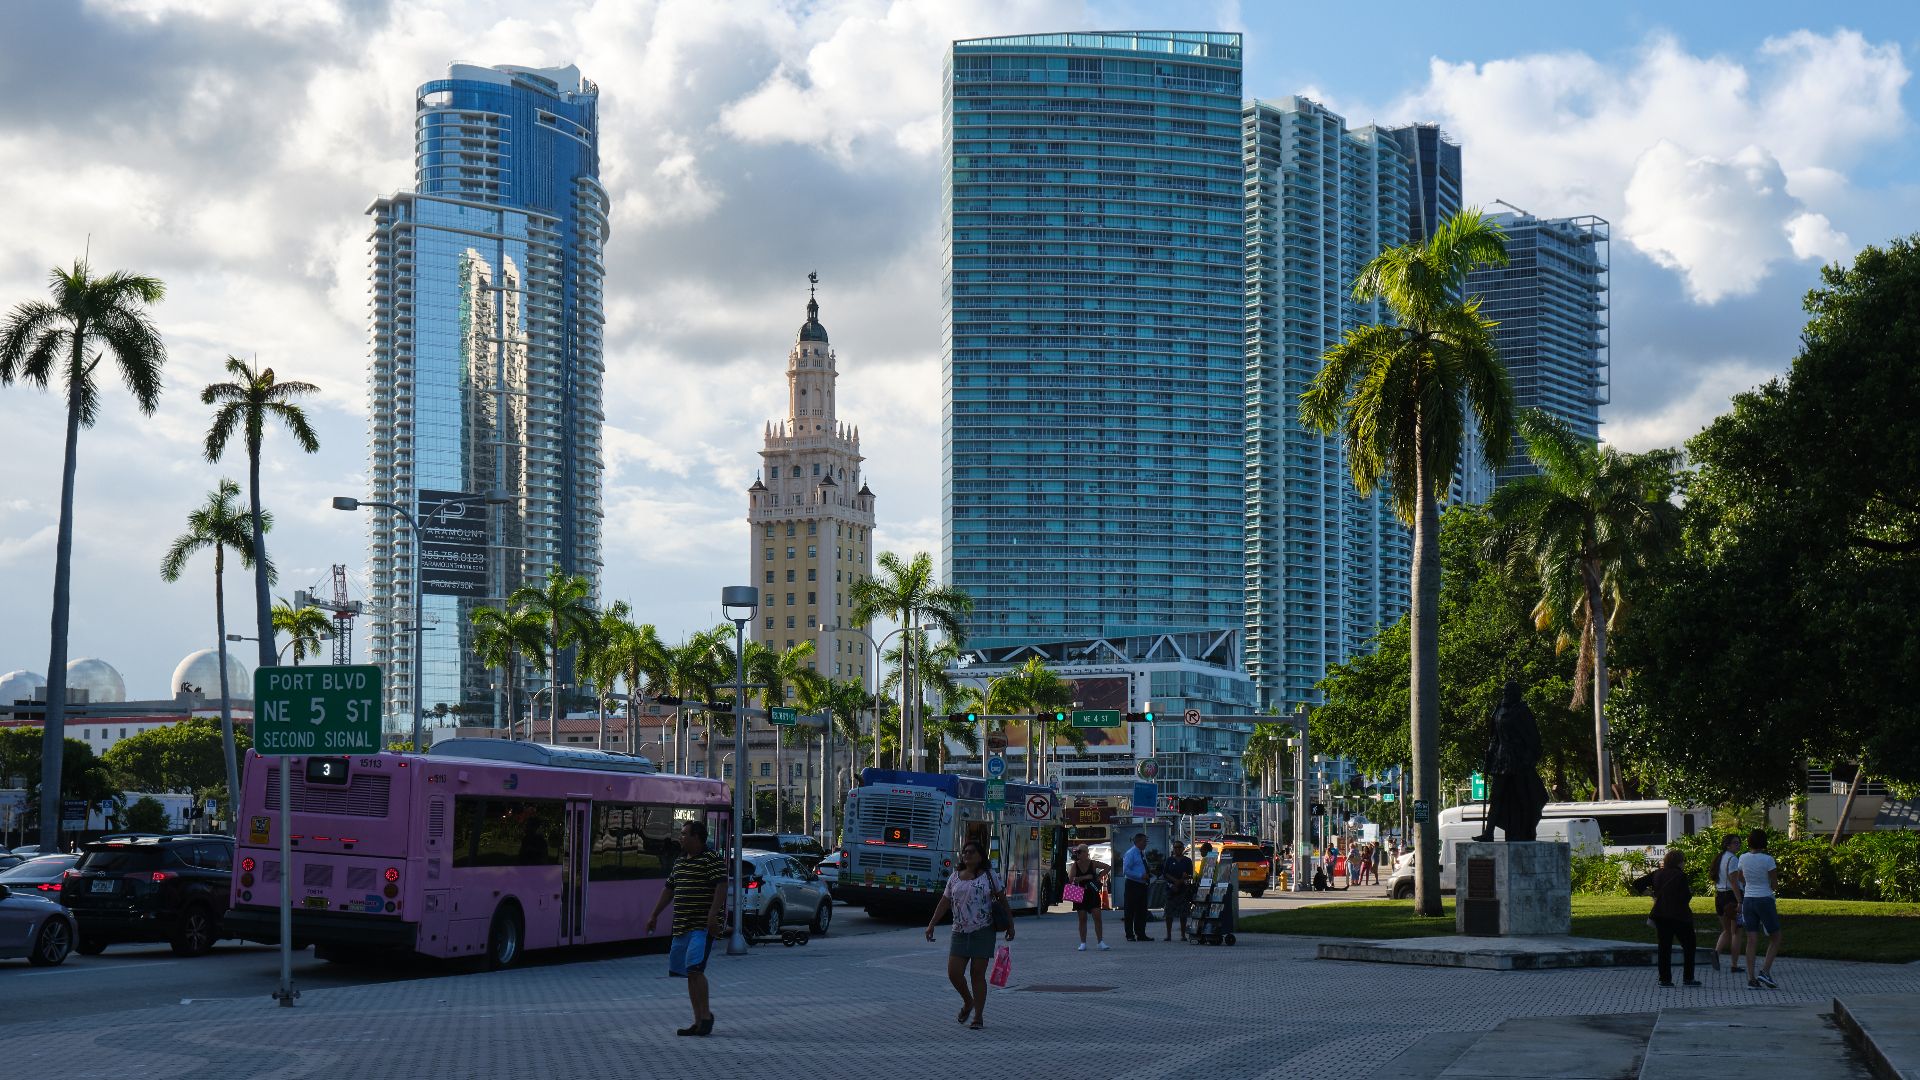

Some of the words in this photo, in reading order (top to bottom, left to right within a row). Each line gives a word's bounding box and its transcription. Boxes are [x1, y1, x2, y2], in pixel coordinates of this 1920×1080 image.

[270, 674, 314, 690] PORT
[322, 673, 366, 690] BLVD
[263, 699, 291, 722] NE
[309, 696, 326, 726] 5
[345, 698, 373, 723] ST
[1083, 715, 1091, 723] NE
[1093, 714, 1099, 723] 4
[1101, 714, 1108, 723] ST
[263, 731, 316, 749] SECOND
[324, 730, 373, 748] SIGNAL
[323, 763, 331, 776] 3
[360, 758, 382, 769] 15113
[893, 830, 901, 839] S
